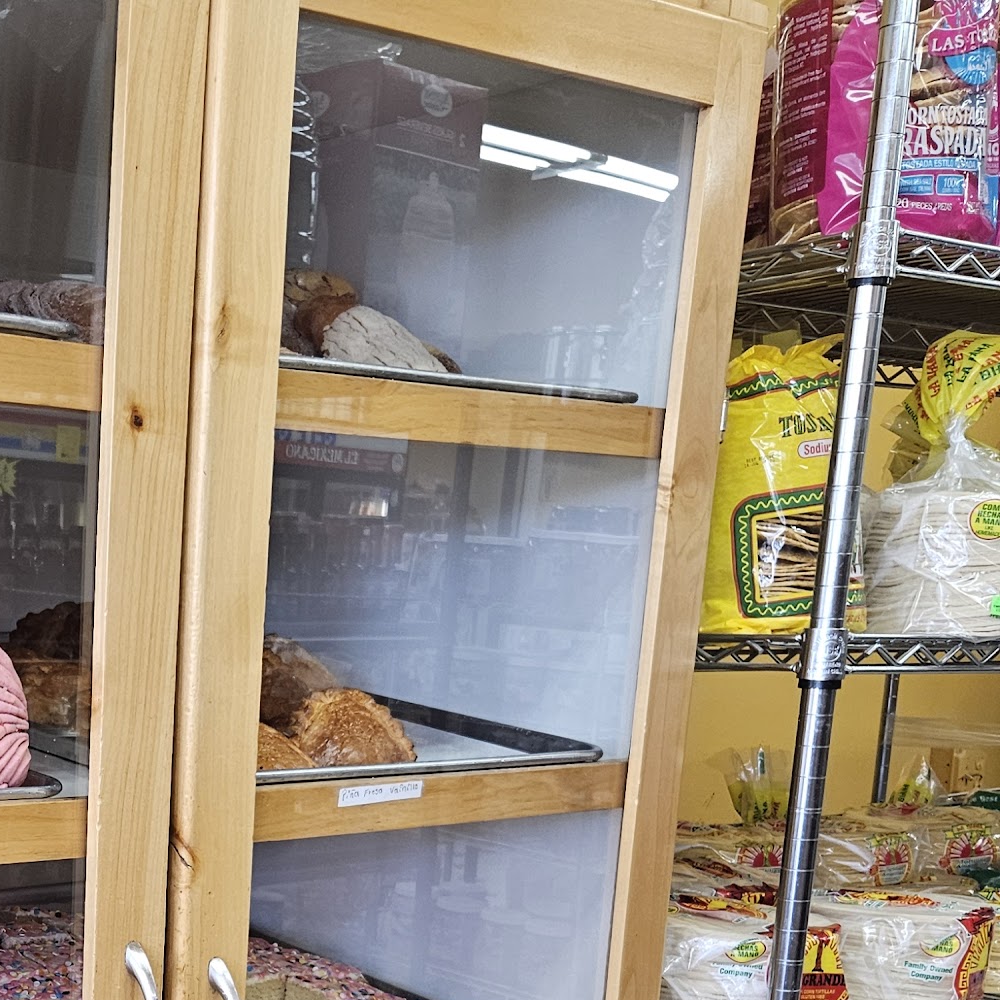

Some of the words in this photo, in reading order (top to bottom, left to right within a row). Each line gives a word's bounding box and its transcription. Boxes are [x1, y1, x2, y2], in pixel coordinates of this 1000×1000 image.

[931, 34, 965, 52] LAS
[906, 105, 938, 125] ORN
[904, 961, 928, 972] Family
[720, 968, 753, 978] Company
[911, 971, 943, 981] Company
